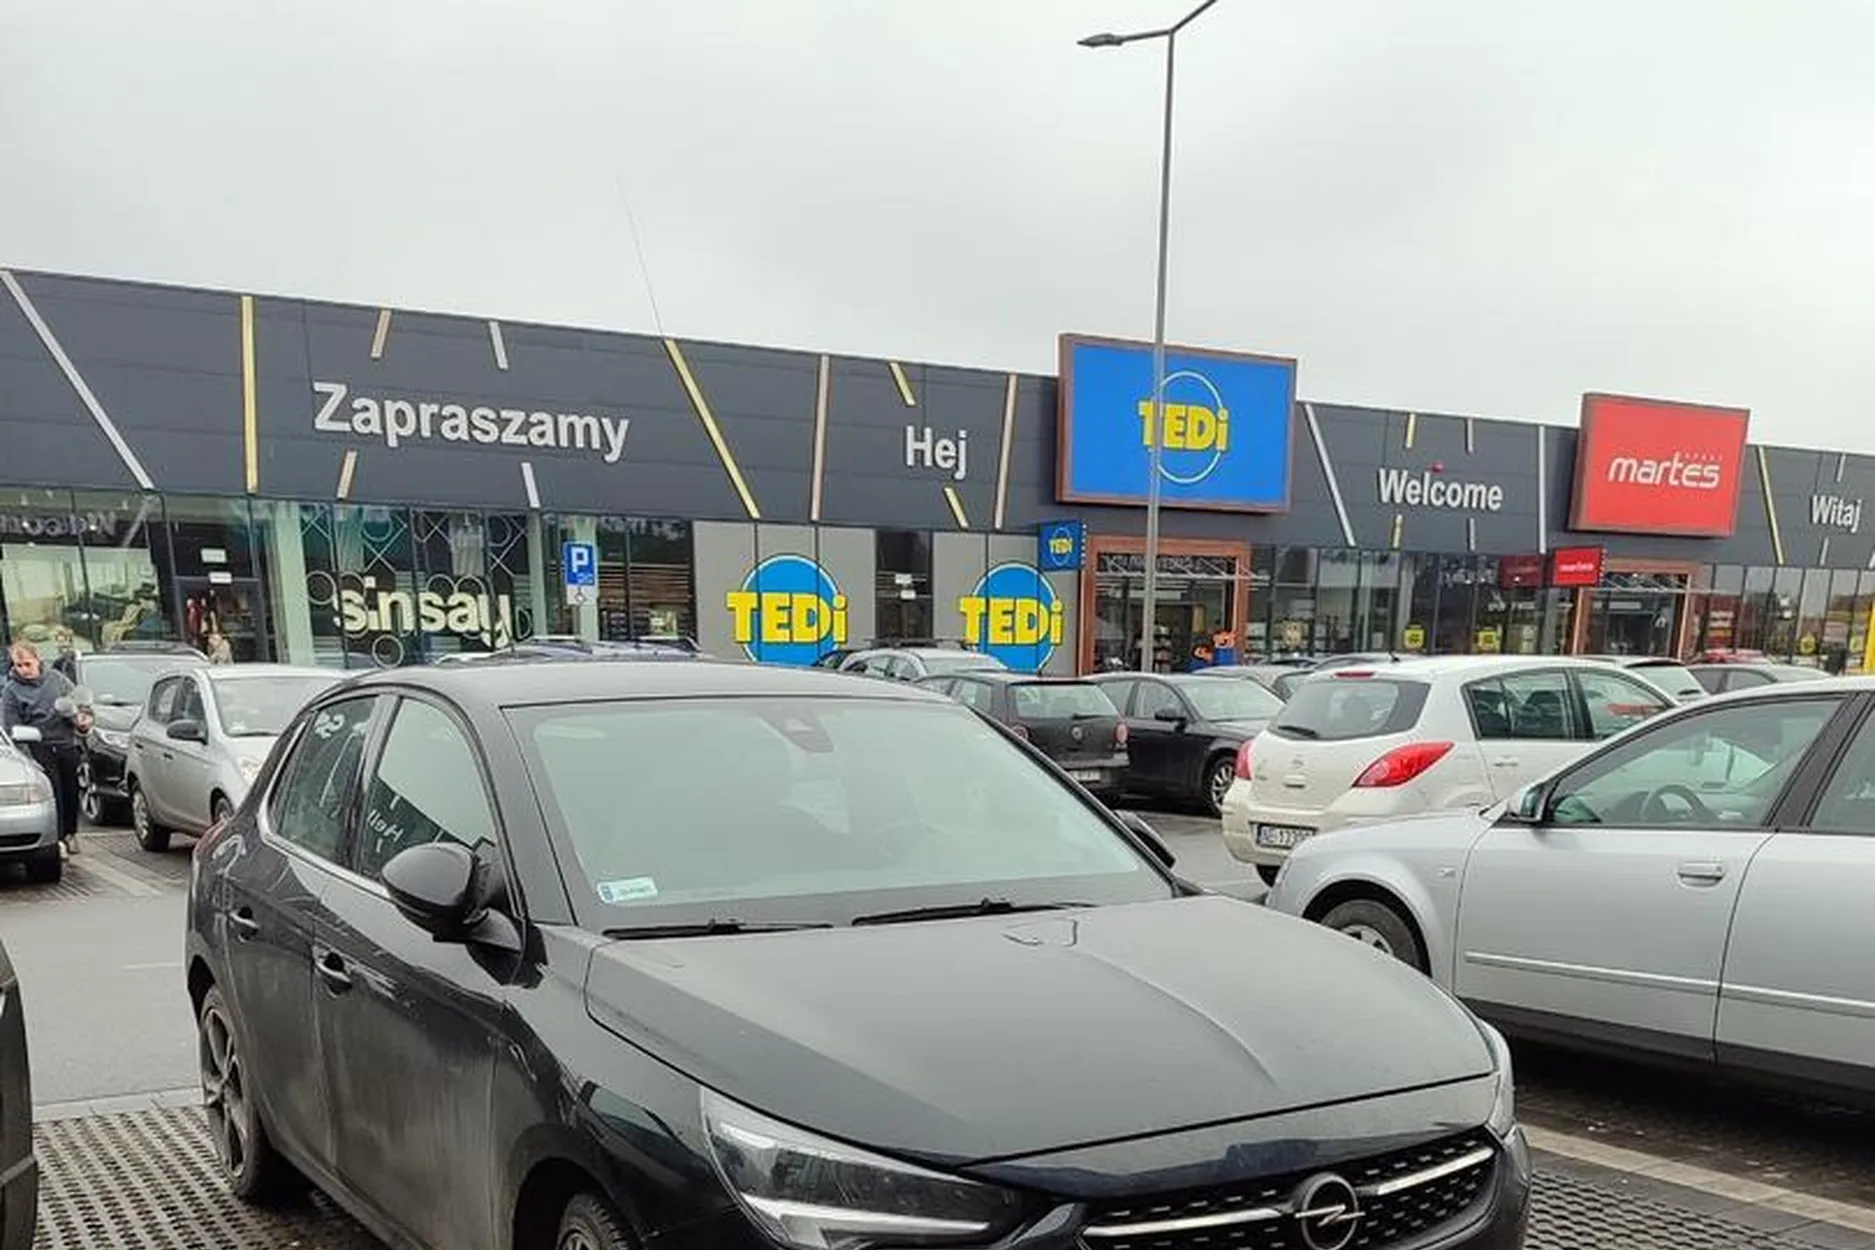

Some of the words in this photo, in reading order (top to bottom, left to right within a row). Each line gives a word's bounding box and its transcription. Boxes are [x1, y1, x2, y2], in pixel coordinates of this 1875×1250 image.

[312, 381, 631, 463] Zapraszamy
[1138, 400, 1229, 452] TEDi
[905, 425, 968, 480] Hej
[1608, 451, 1720, 489] martes
[1377, 467, 1503, 511] Welcome
[1810, 495, 1862, 534] Witaj
[571, 546, 589, 573] P
[334, 575, 513, 648] sinsay
[727, 590, 848, 645] TEDi
[960, 595, 1064, 646] TEDi
